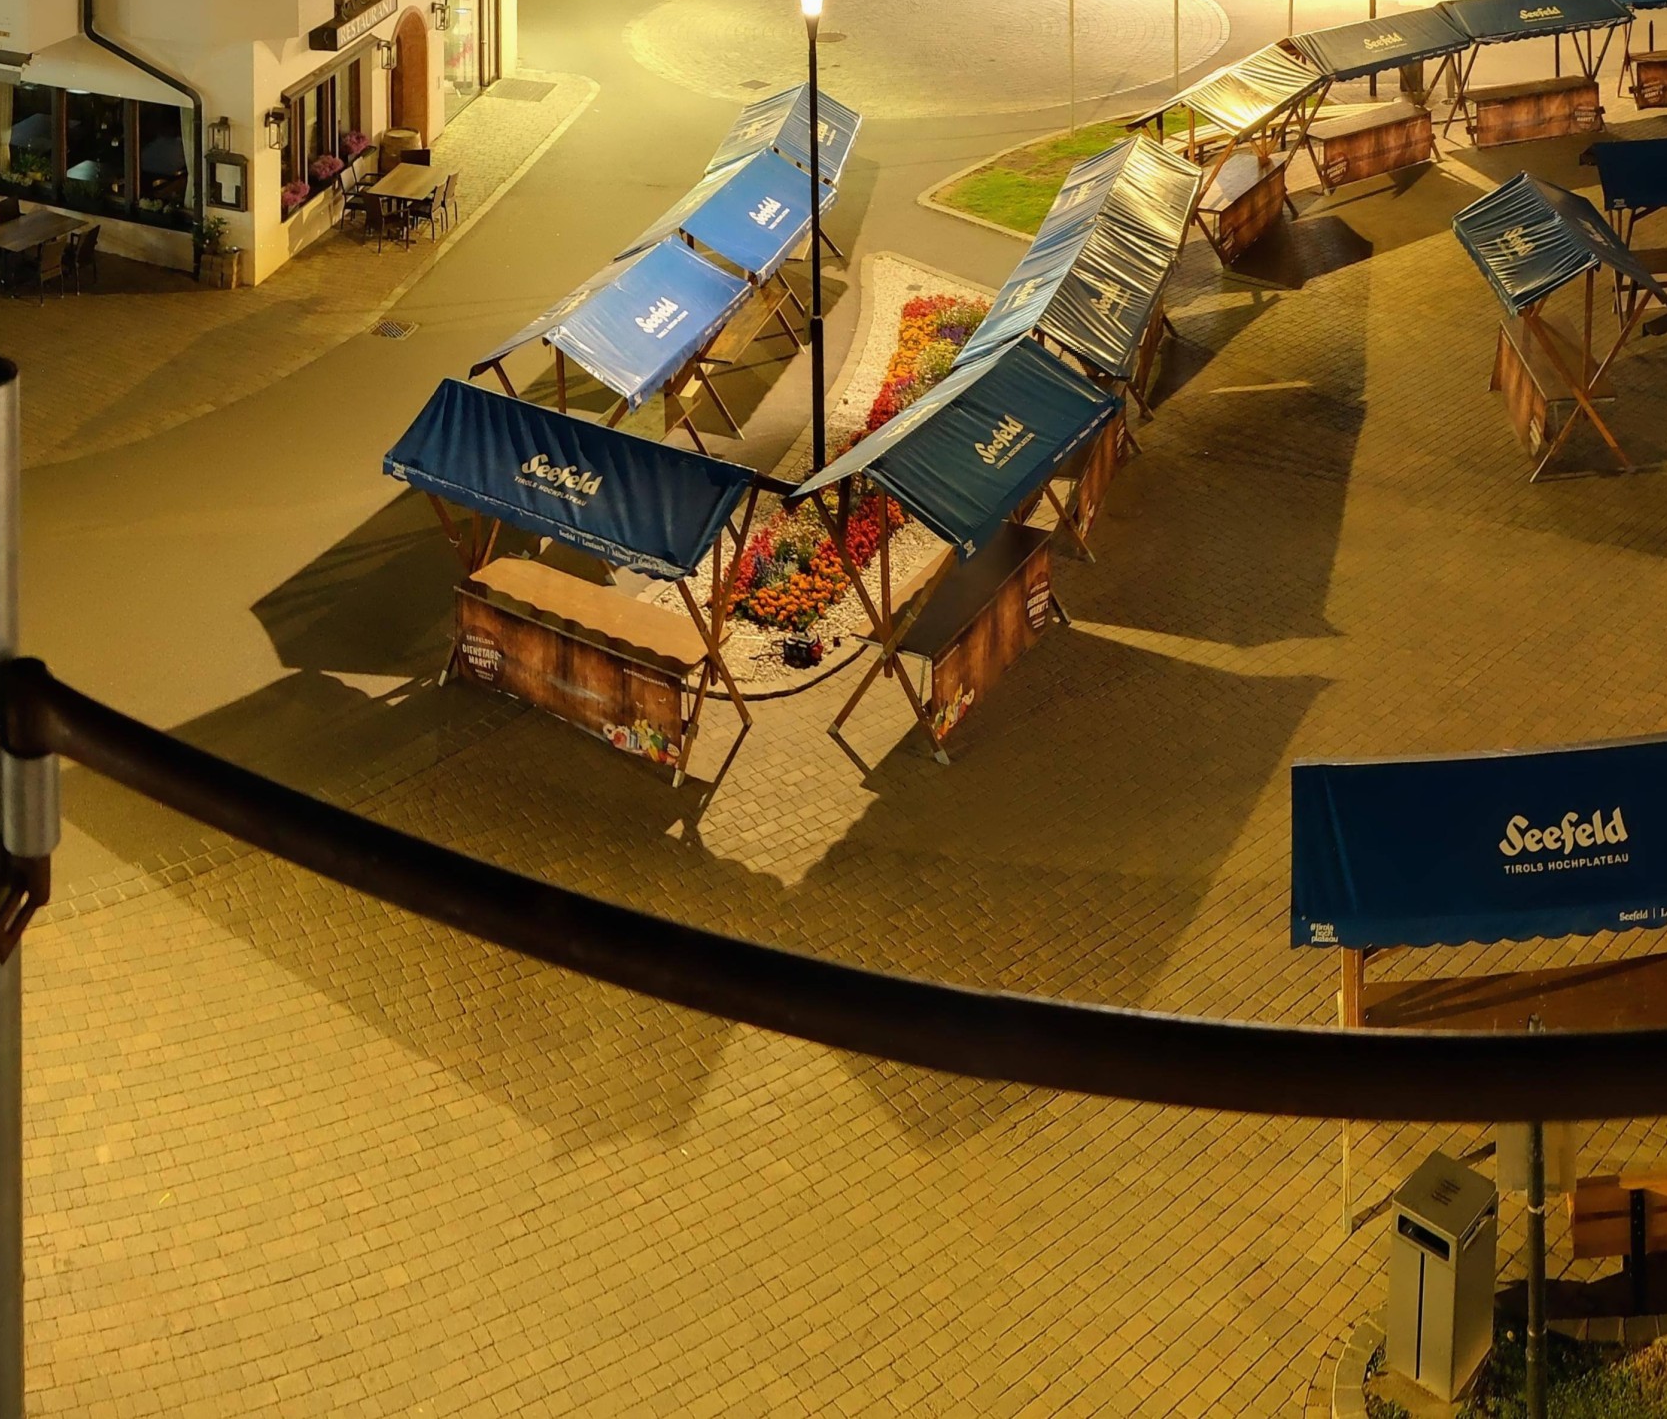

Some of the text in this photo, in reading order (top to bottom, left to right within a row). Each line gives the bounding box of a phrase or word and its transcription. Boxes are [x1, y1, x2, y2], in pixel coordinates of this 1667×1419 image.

[340, 0, 393, 44] RESTAURANT
[974, 413, 1024, 465] Seefeld
[521, 452, 604, 497] Seefeld
[462, 644, 503, 660] DIENSTAGS-
[468, 655, 499, 671] MARKT'L
[1498, 806, 1629, 856] Seefeld
[1504, 853, 1630, 875] TIROLS HOCHPLATEAU
[1620, 908, 1649, 921] Seefeld
